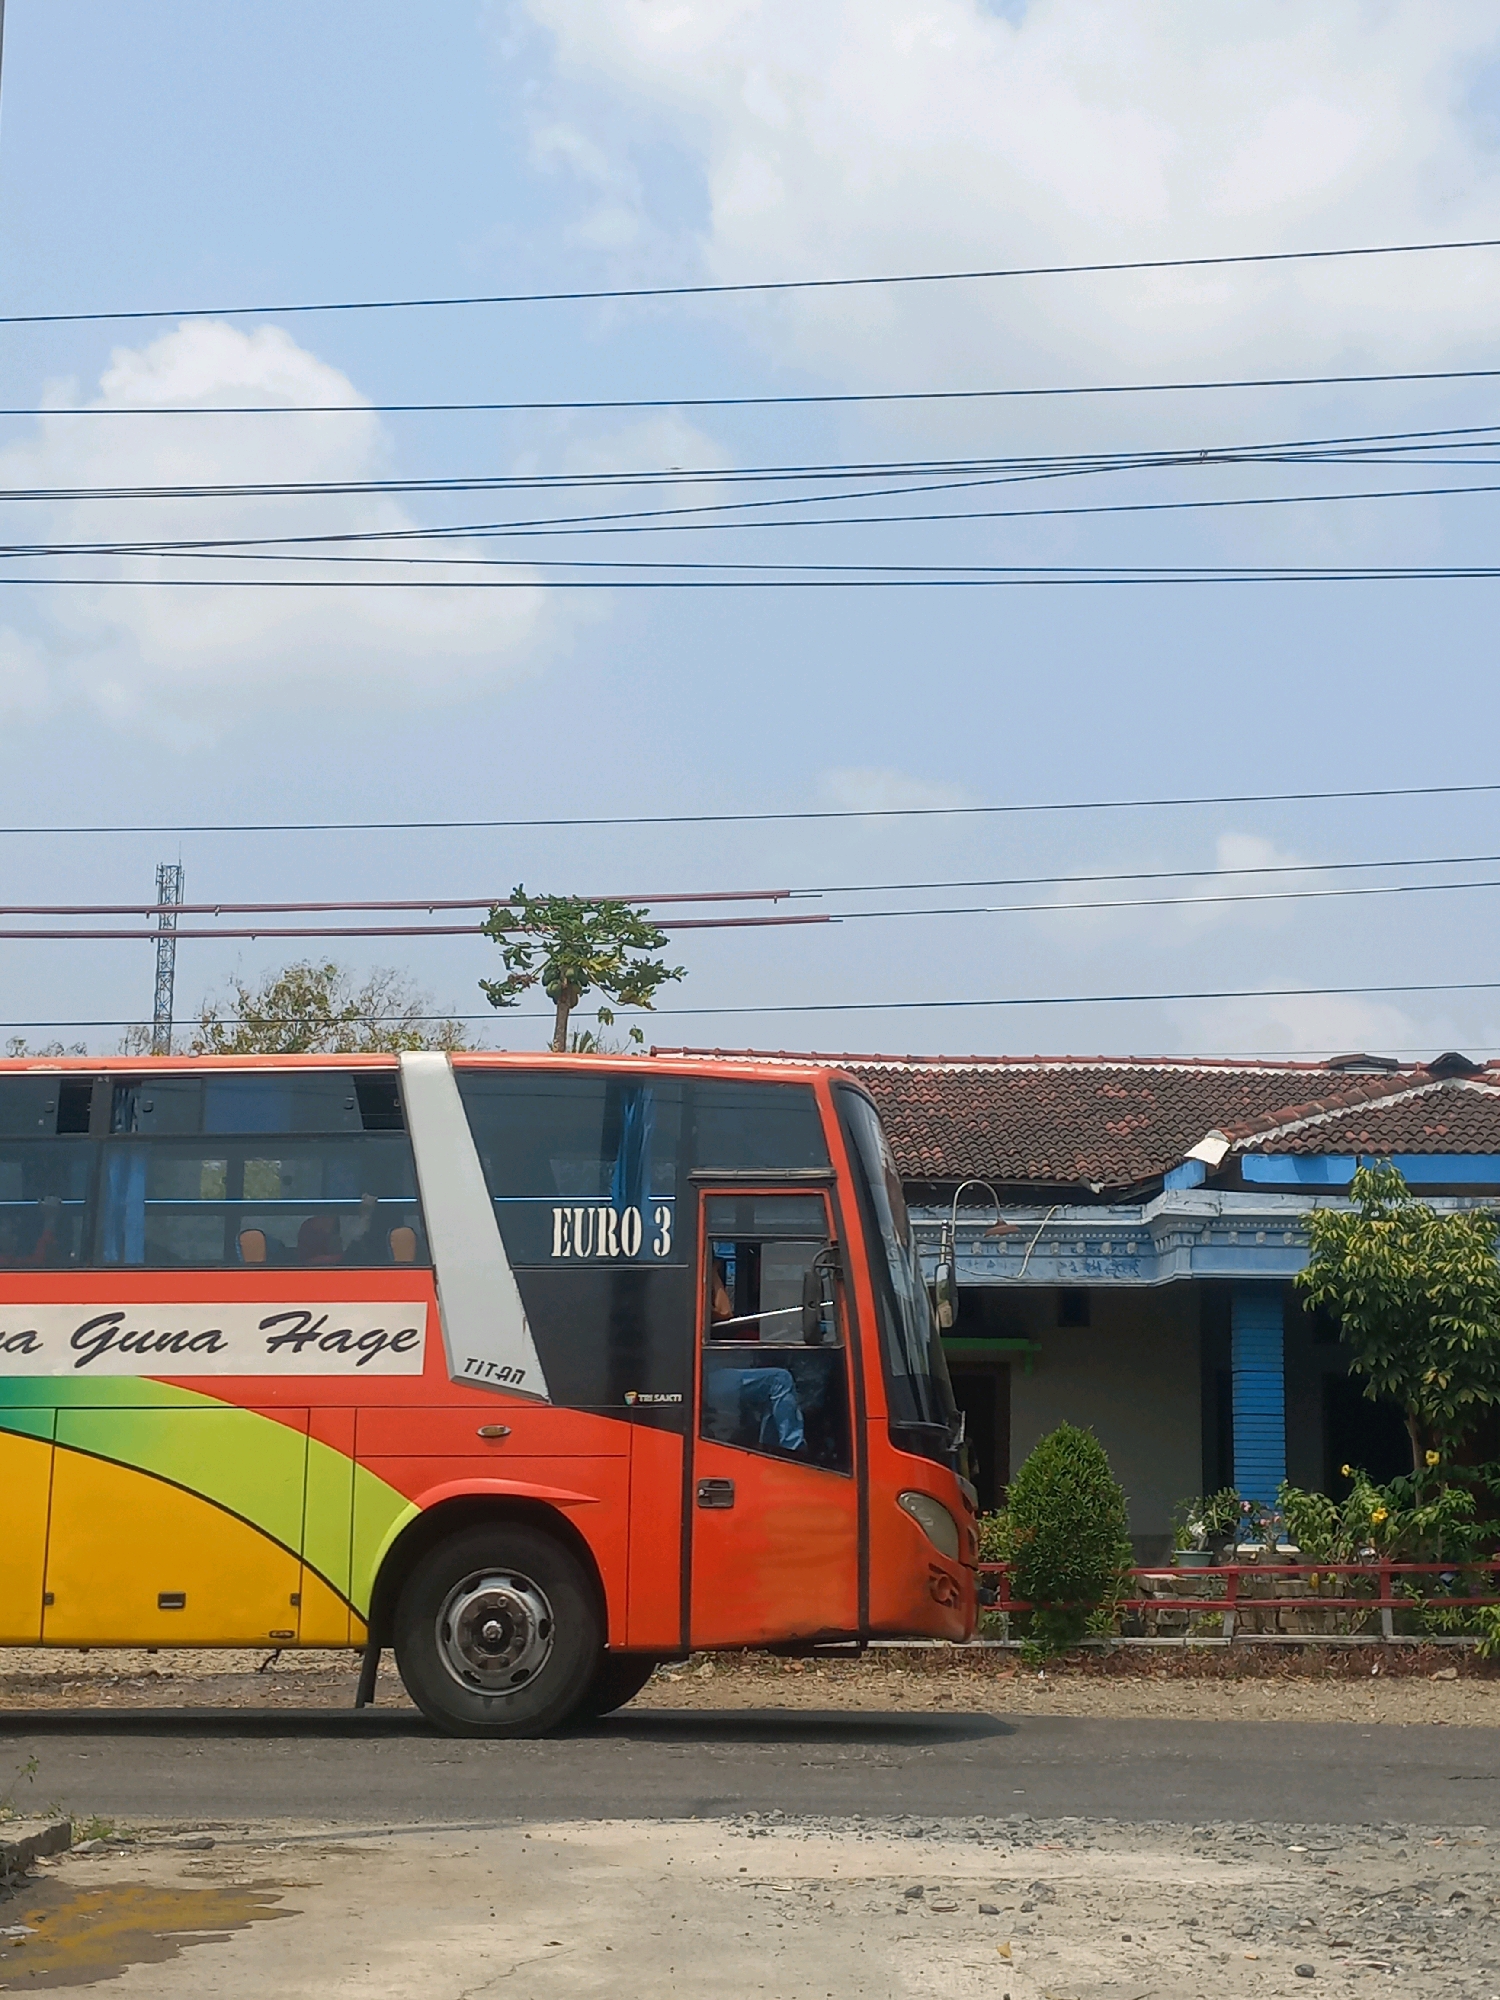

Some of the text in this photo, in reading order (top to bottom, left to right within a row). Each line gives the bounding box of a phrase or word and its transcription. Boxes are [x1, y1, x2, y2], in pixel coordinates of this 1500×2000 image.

[551, 1206, 671, 1257] EURO 3
[0, 1310, 421, 1368] a Guna Hage
[653, 1394, 682, 1402] SAKTI
